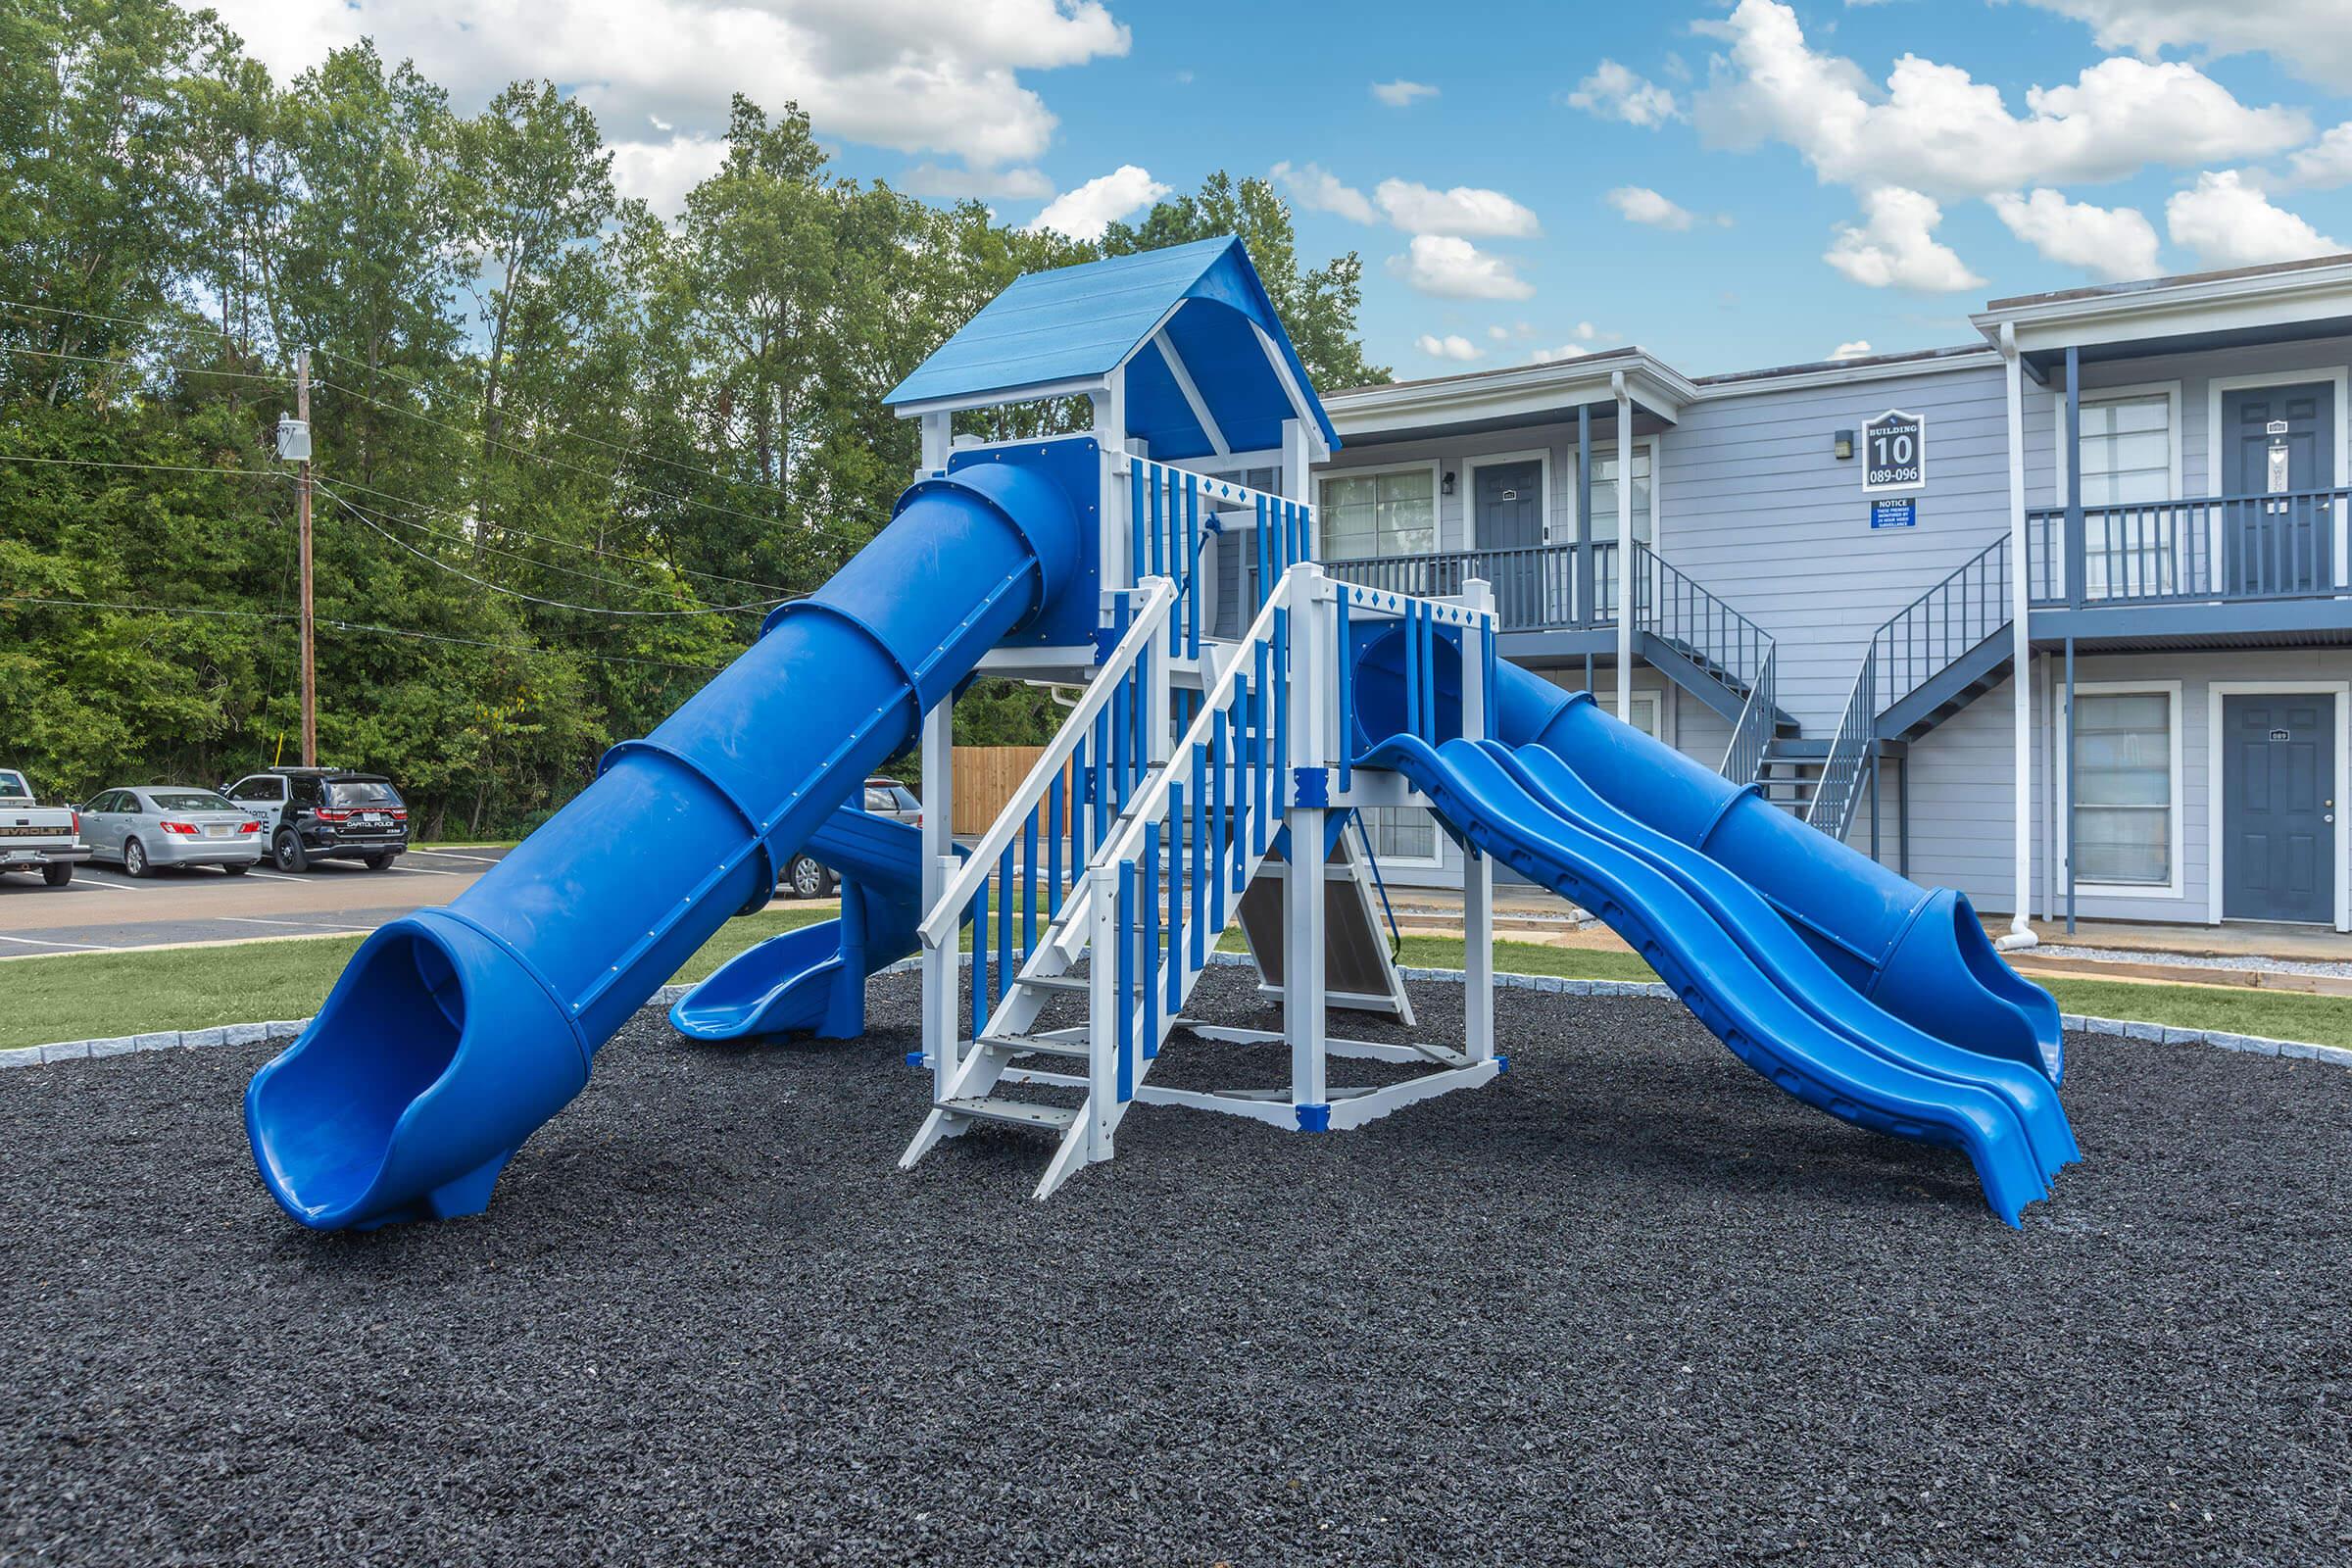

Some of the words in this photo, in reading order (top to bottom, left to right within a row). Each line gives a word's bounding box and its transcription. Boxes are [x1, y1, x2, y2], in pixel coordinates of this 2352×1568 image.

[1869, 425, 1917, 436] BUILDING
[1875, 435, 1912, 466] 10
[1870, 467, 1918, 483] 089-096
